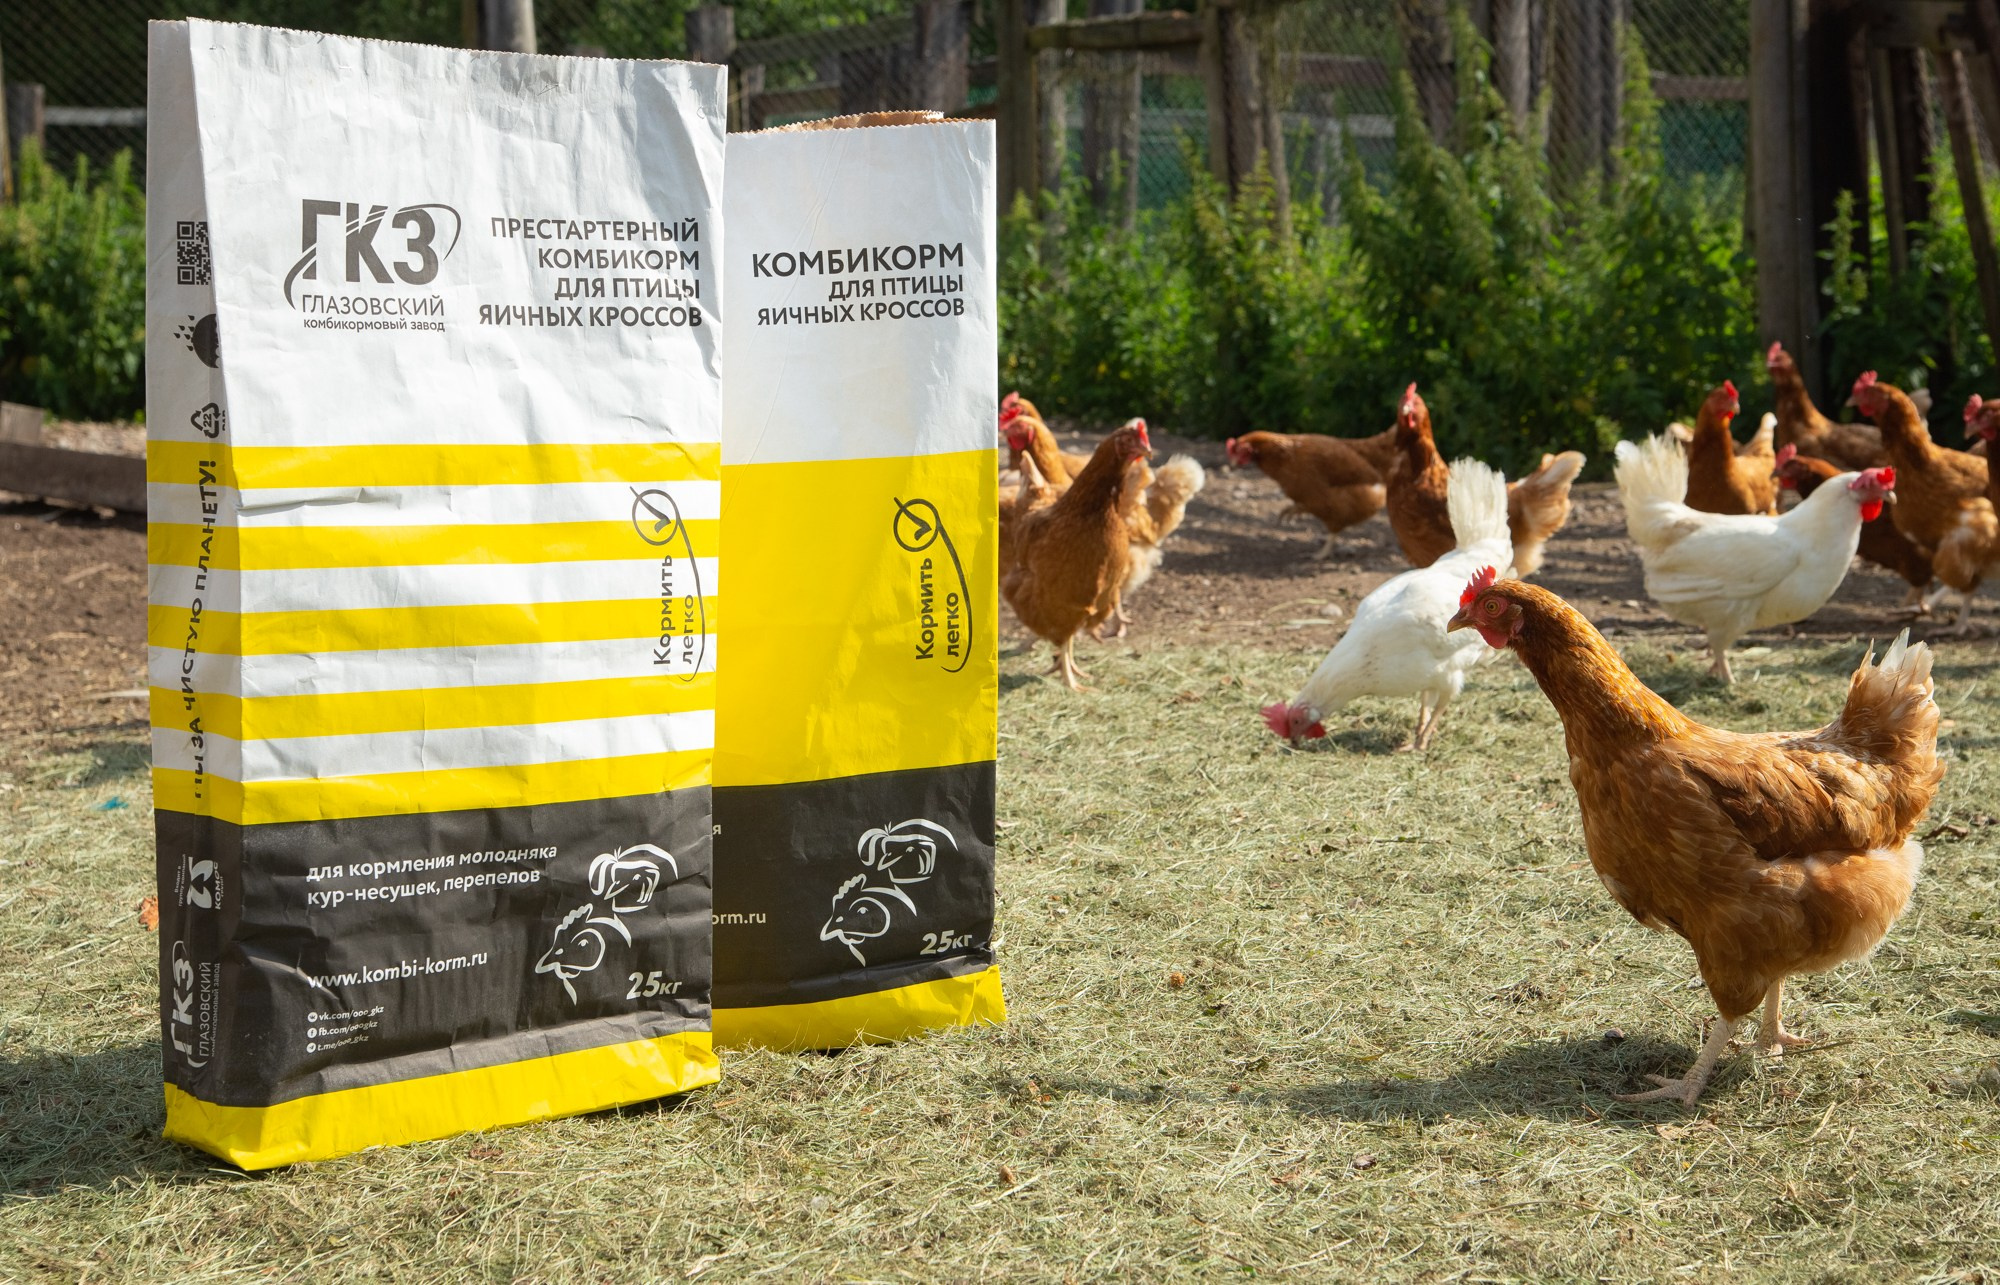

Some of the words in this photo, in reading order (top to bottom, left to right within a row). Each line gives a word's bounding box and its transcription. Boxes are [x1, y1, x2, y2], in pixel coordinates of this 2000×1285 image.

[302, 198, 440, 286] ГКЗ
[490, 216, 700, 243] ПРЕСТАРТЕРНЫЙ
[538, 247, 700, 271] КОМБИКОРМ
[752, 242, 964, 278] КОМБИКОРМ
[554, 277, 606, 301] ДЛЯ
[612, 277, 700, 302] ПТИЦЫ
[828, 279, 875, 302] ДЛЯ
[881, 274, 964, 296] ПТИЦЫ
[301, 294, 446, 317] ГЛАЗОВСКИЙ
[479, 303, 584, 327] ЯИЧНЫХ
[589, 305, 703, 328] КРОССОВ
[757, 303, 856, 326] ЯИЧНЫХ
[860, 297, 966, 322] КРОССОВ
[303, 317, 408, 333] комбикормовый
[410, 320, 446, 333] завод
[202, 412, 213, 428] 22
[194, 460, 219, 591] ПЛАНЕТУ!
[653, 554, 676, 666] Кормить
[915, 557, 939, 660] Кормить
[945, 592, 960, 658] легко
[682, 594, 695, 665] легко
[180, 597, 203, 711] ЧИСТУЮ
[189, 716, 204, 750] ЗА
[306, 864, 344, 883] для
[349, 853, 455, 880] кормления
[459, 845, 558, 867] молодняка
[307, 880, 442, 909] кур-несушек,
[443, 869, 541, 893] перепелов
[920, 929, 973, 956] 25кг
[306, 951, 488, 989] www.kombi-korm.ru
[625, 970, 683, 1001] 25кг
[199, 961, 212, 1057] ГЛАЗОВСКИЙ
[318, 1005, 385, 1021] vk.com/ooo_gkz
